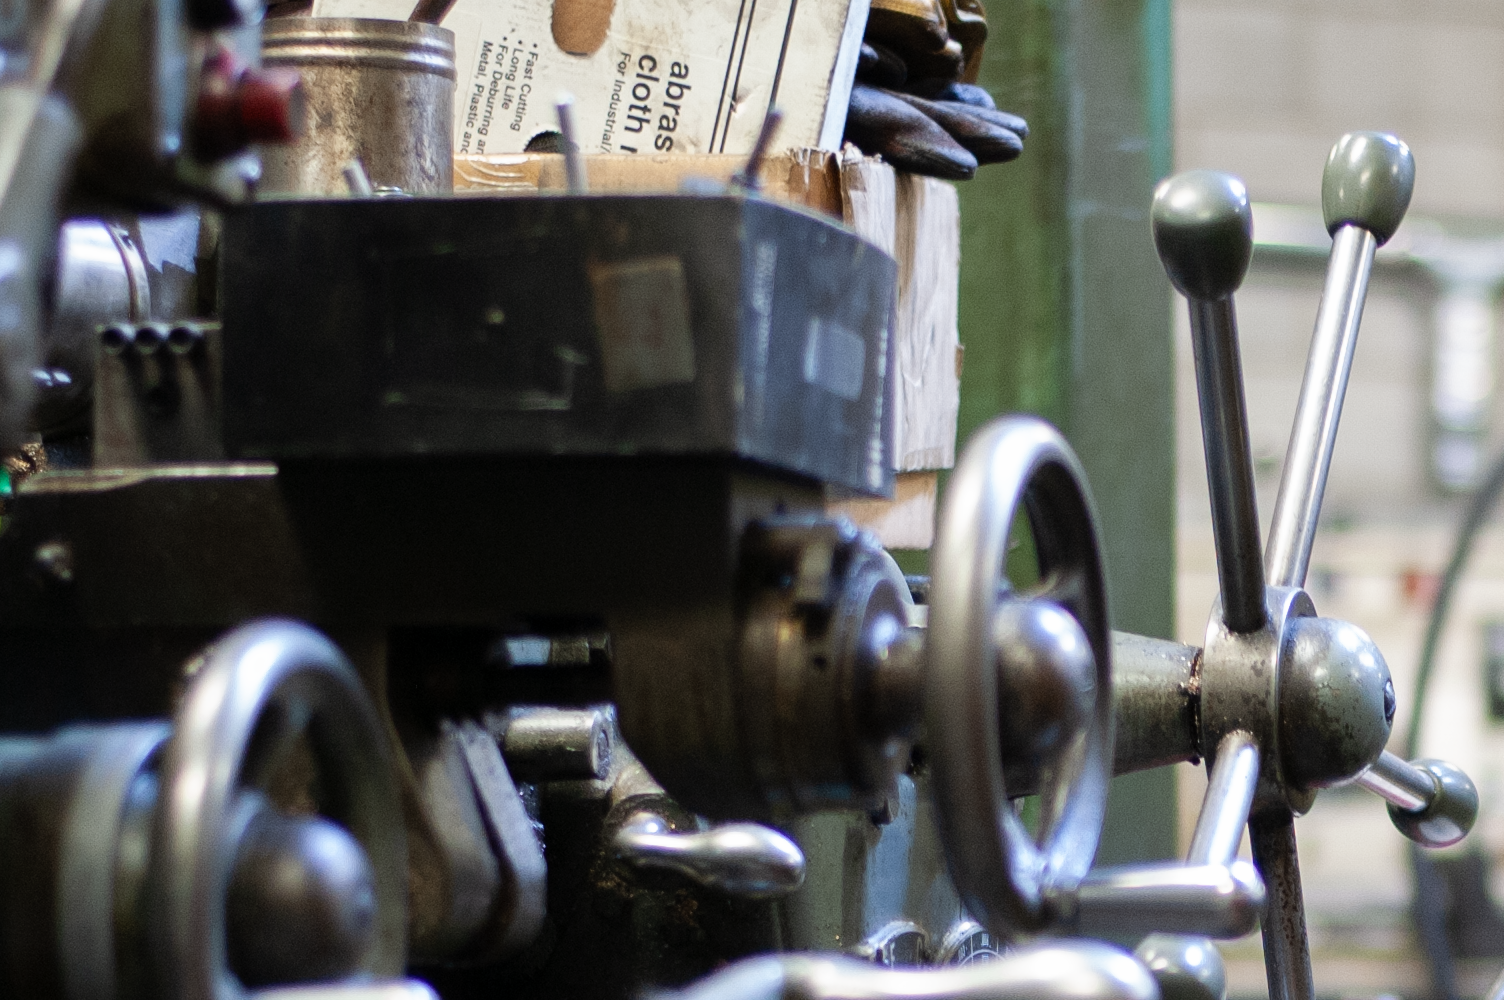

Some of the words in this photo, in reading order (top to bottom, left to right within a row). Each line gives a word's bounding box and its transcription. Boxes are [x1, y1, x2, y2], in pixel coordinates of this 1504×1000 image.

[474, 40, 494, 79] Metal,
[495, 44, 509, 68] For
[504, 47, 524, 82] Long
[523, 51, 539, 81] Fast
[617, 52, 632, 77] For
[465, 83, 485, 129] Plastic
[477, 70, 503, 136] Deburring
[501, 85, 516, 111] Life
[510, 83, 532, 132] Cutting
[624, 54, 660, 133] cloth
[654, 61, 692, 152] abras
